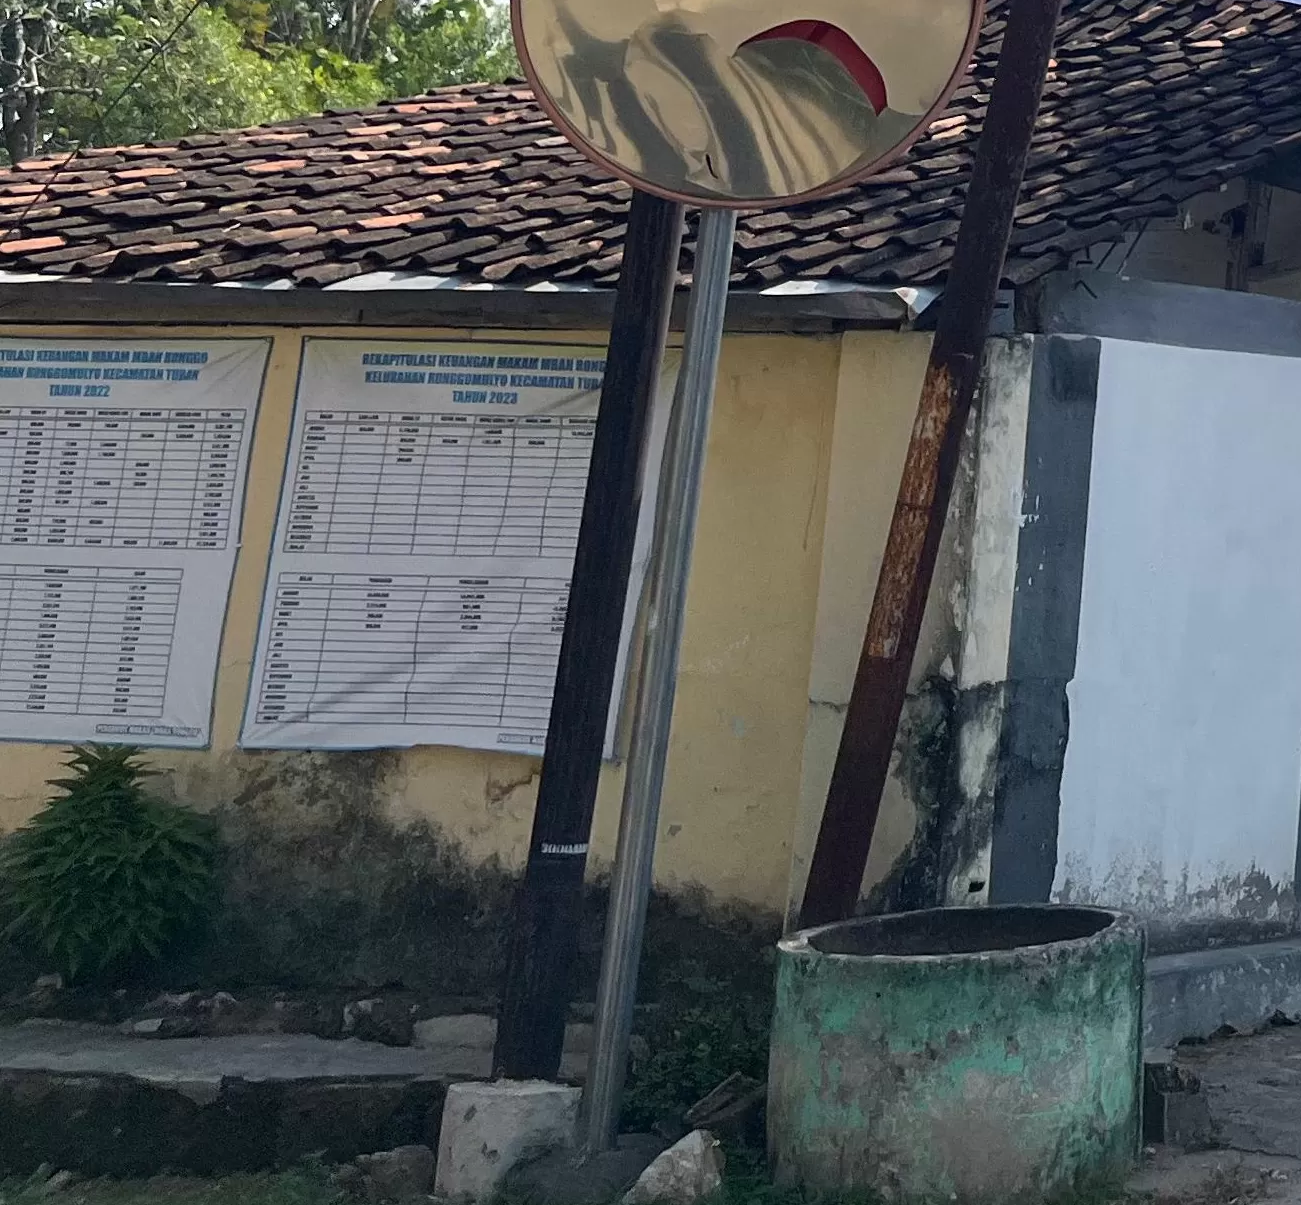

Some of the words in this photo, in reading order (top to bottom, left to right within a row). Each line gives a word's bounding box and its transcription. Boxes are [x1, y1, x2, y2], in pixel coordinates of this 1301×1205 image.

[50, 384, 81, 397] TAHUN
[83, 384, 111, 397] 2022
[452, 389, 487, 404] TAHUN
[488, 391, 518, 405] 2023
